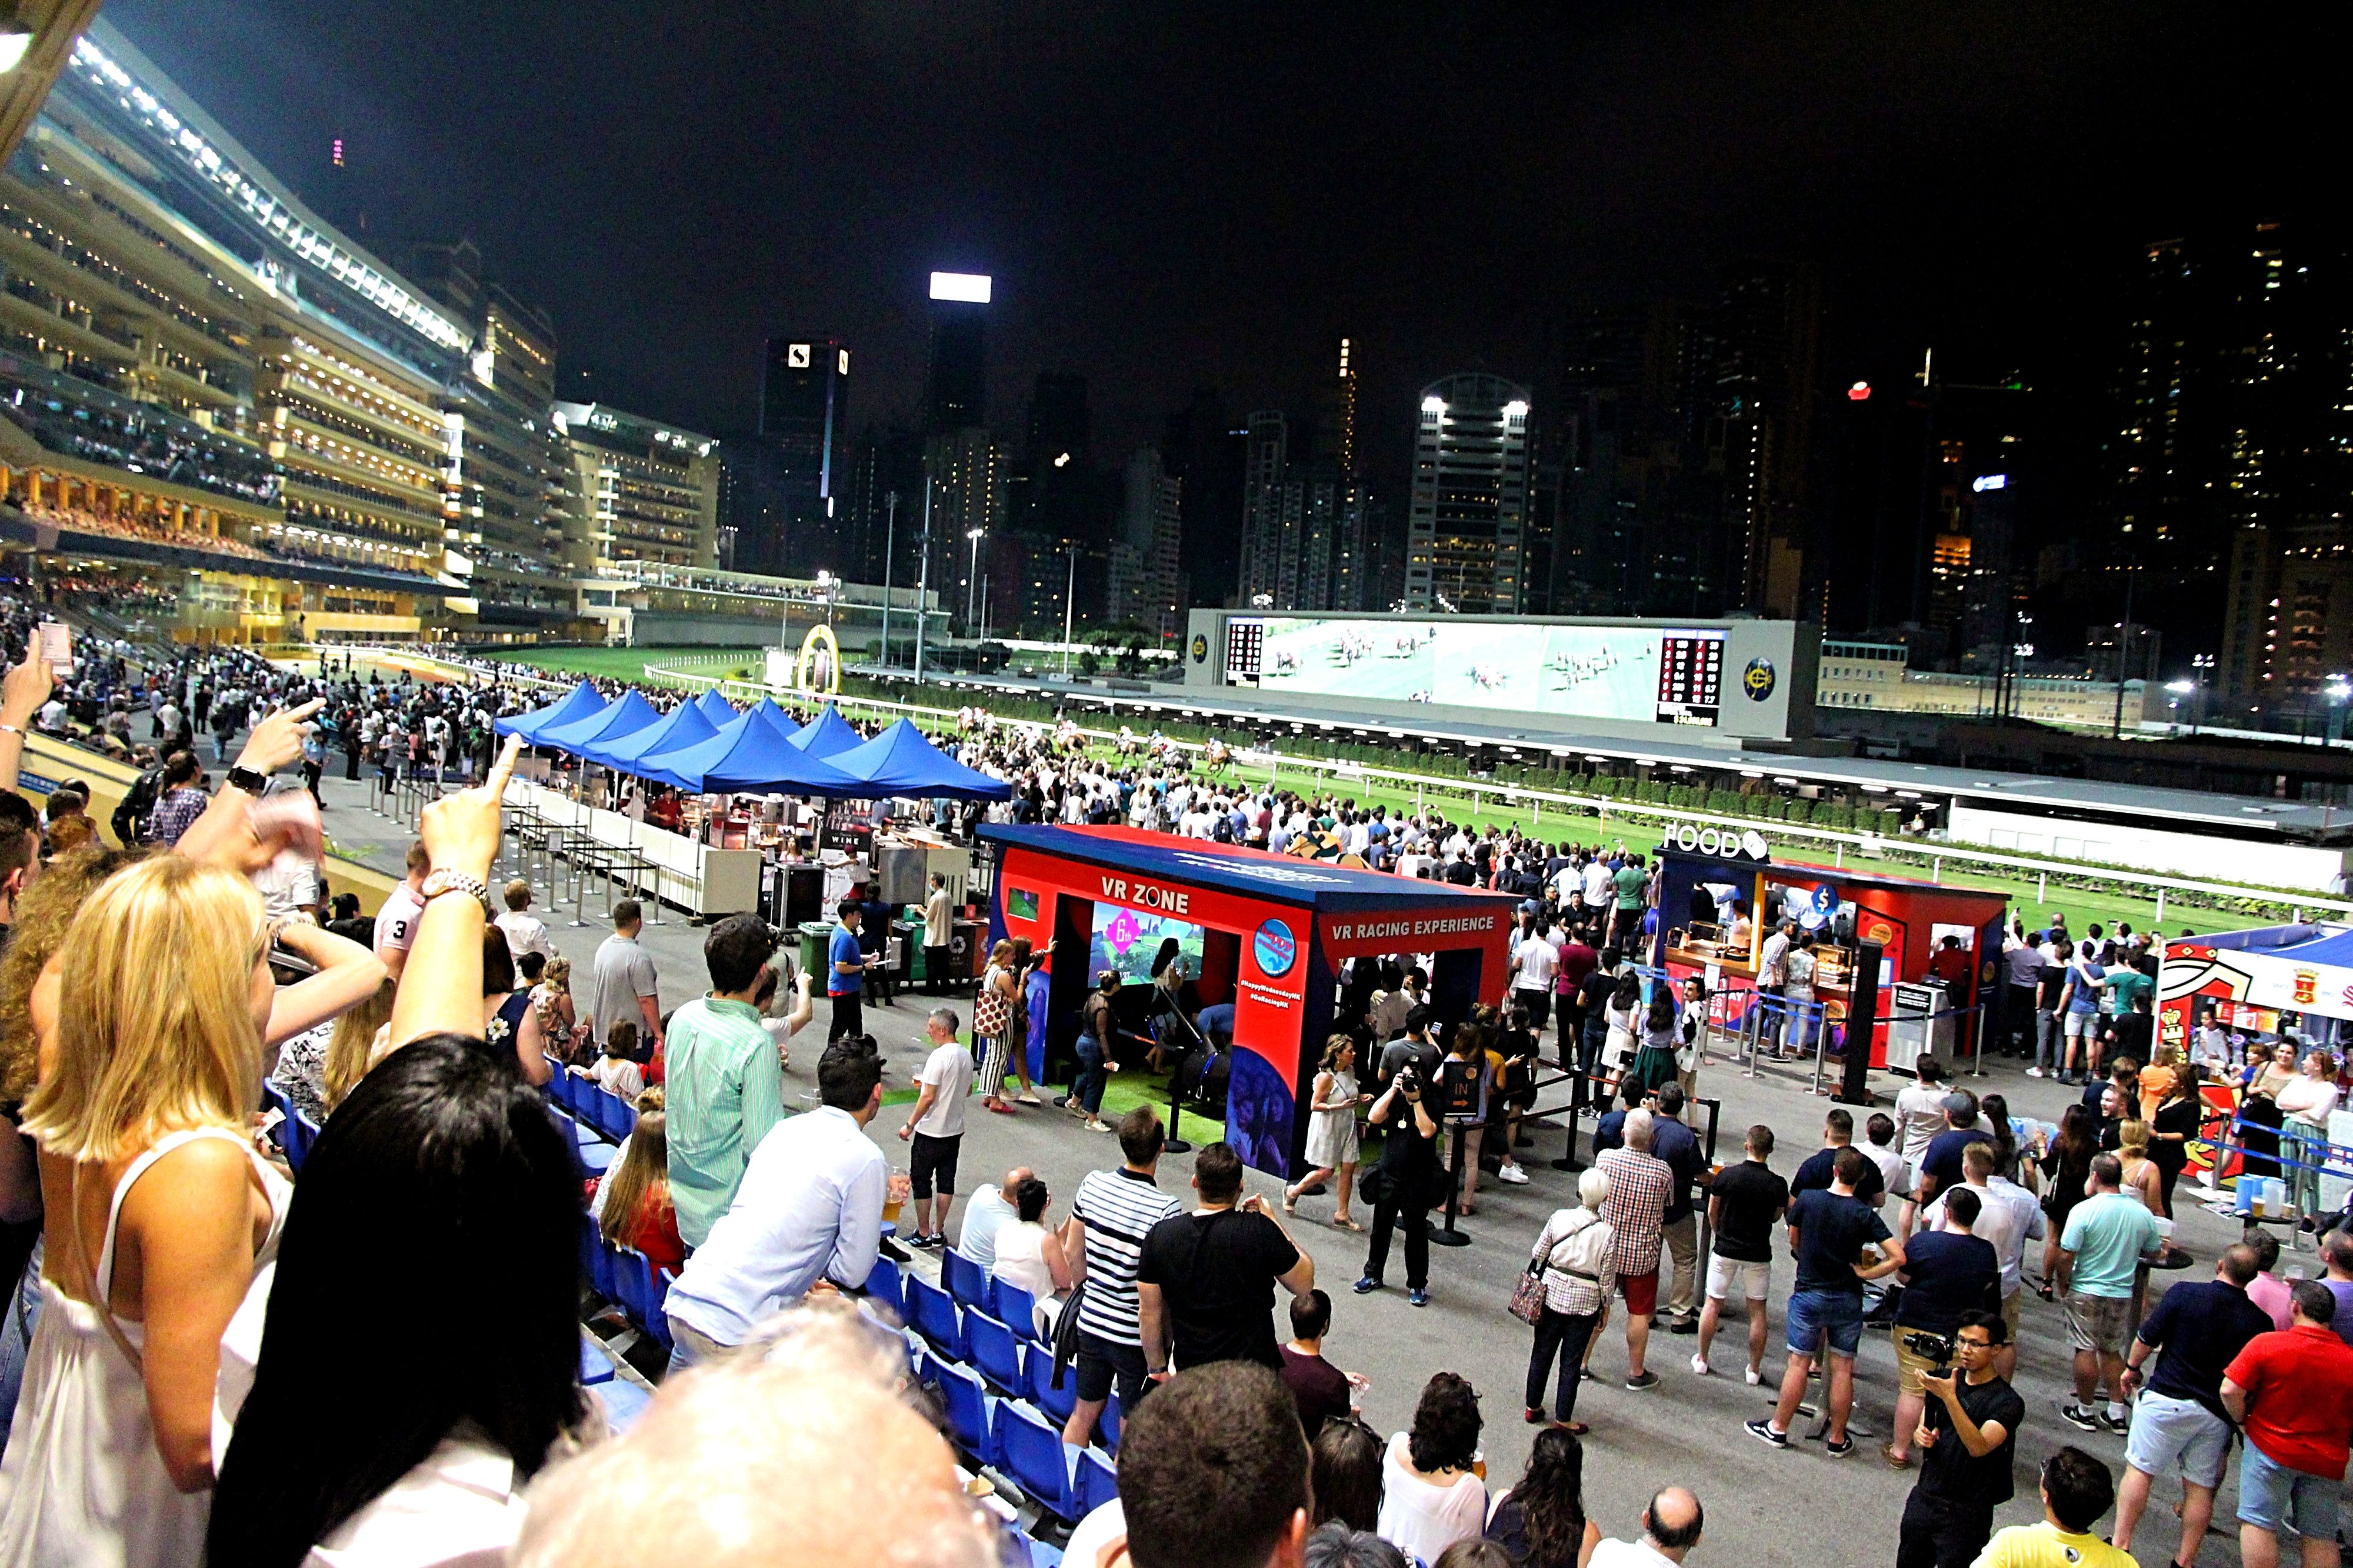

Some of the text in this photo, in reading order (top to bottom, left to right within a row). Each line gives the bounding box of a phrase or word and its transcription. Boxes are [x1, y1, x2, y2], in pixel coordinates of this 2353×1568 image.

[832, 836, 859, 845] WINE
[1664, 823, 1741, 858] FOOD
[1101, 876, 1189, 914] VR ZONE
[393, 920, 407, 939] 3
[1116, 919, 1132, 943] 6th
[1332, 916, 1494, 940] VR RACING EXPERIENCE
[1241, 979, 1301, 1000] #HappyWednesdayHK
[1250, 993, 1289, 1009] #GoRacingHK
[1455, 1083, 1468, 1095] IN
